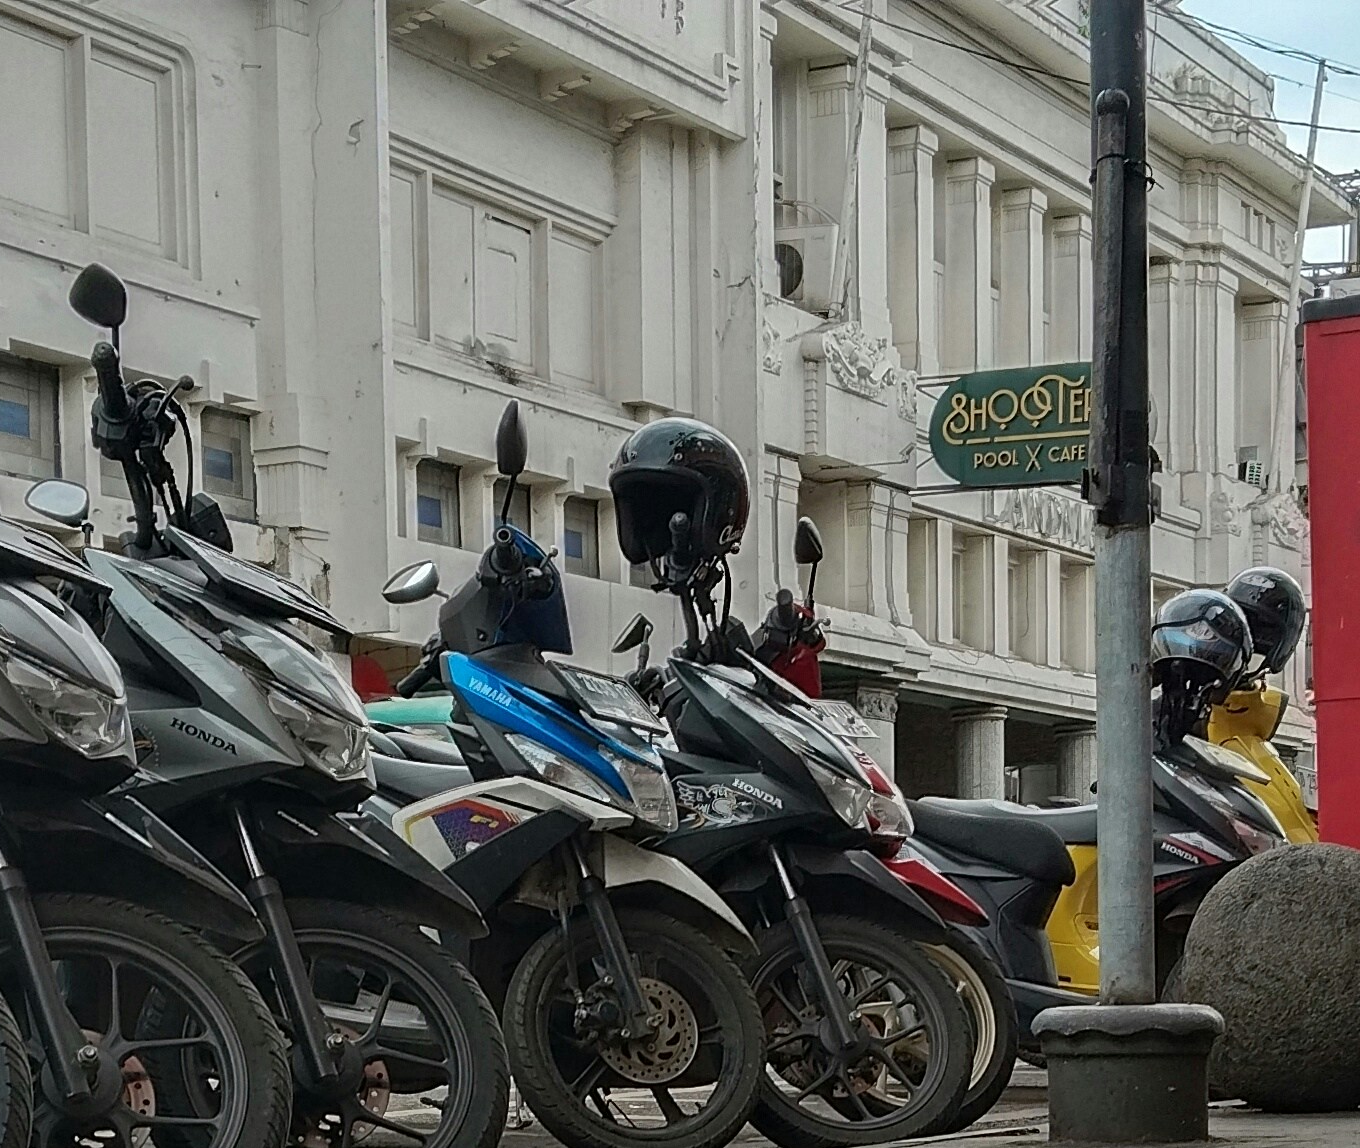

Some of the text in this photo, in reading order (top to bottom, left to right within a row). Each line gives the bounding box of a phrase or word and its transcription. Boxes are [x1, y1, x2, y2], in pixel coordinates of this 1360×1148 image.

[973, 444, 1086, 472] POOL X CAFE
[468, 676, 512, 707] YAMAHA
[170, 716, 239, 756] HONDA
[731, 778, 784, 810] HONDA
[1160, 842, 1200, 865] HONDA
